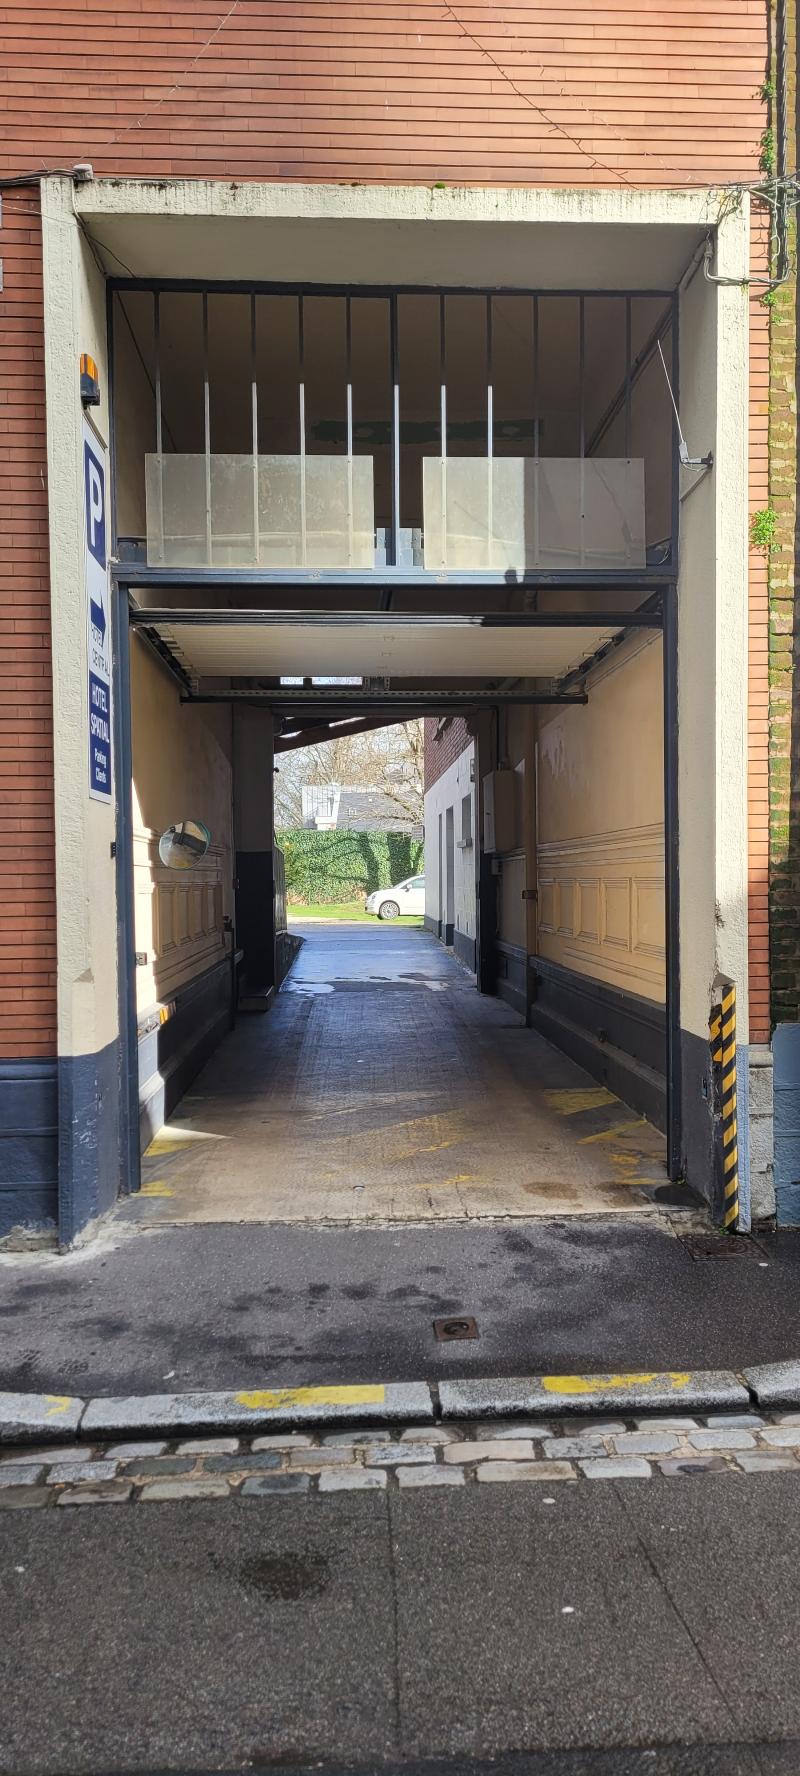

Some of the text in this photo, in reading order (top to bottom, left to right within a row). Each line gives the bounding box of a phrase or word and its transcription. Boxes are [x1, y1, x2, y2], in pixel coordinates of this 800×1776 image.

[88, 457, 103, 547] P
[92, 682, 108, 713] HOTEL
[91, 712, 110, 743] SPATIAL
[95, 747, 107, 768] Parking
[96, 767, 107, 784] Clients
